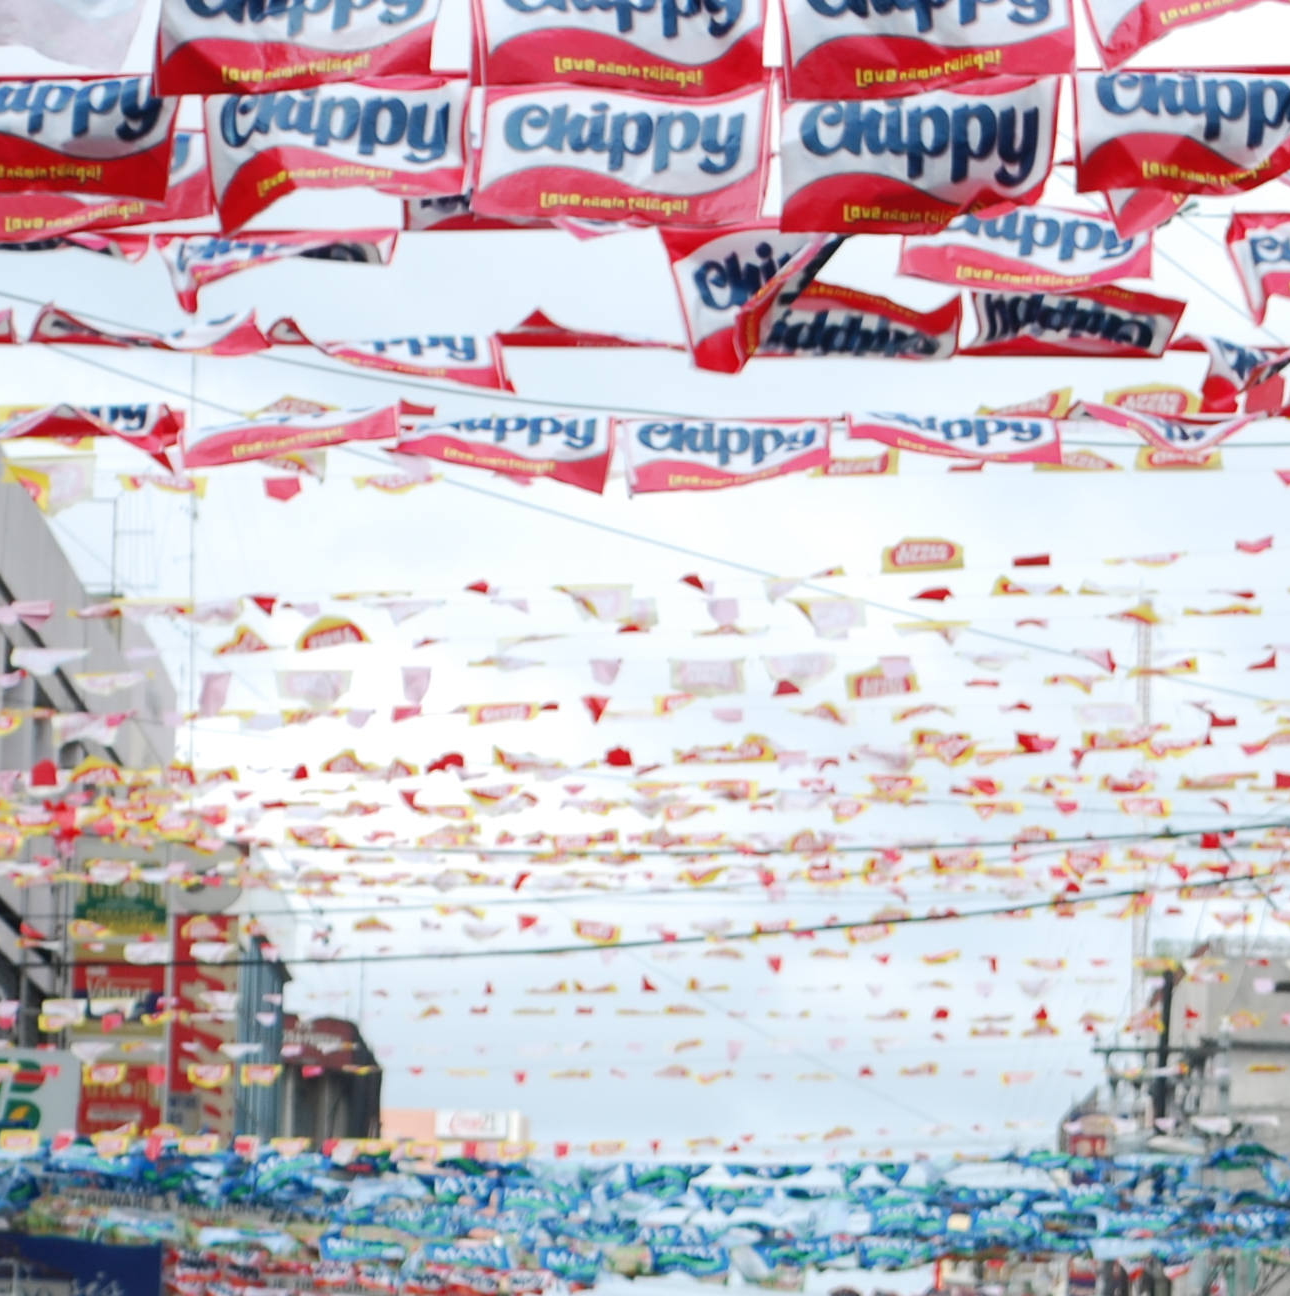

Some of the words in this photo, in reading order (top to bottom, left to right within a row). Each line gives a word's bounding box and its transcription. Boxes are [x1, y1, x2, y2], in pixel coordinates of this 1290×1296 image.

[220, 88, 451, 165] Chippy
[504, 101, 745, 175] Chippy
[800, 100, 1040, 187] Chippy
